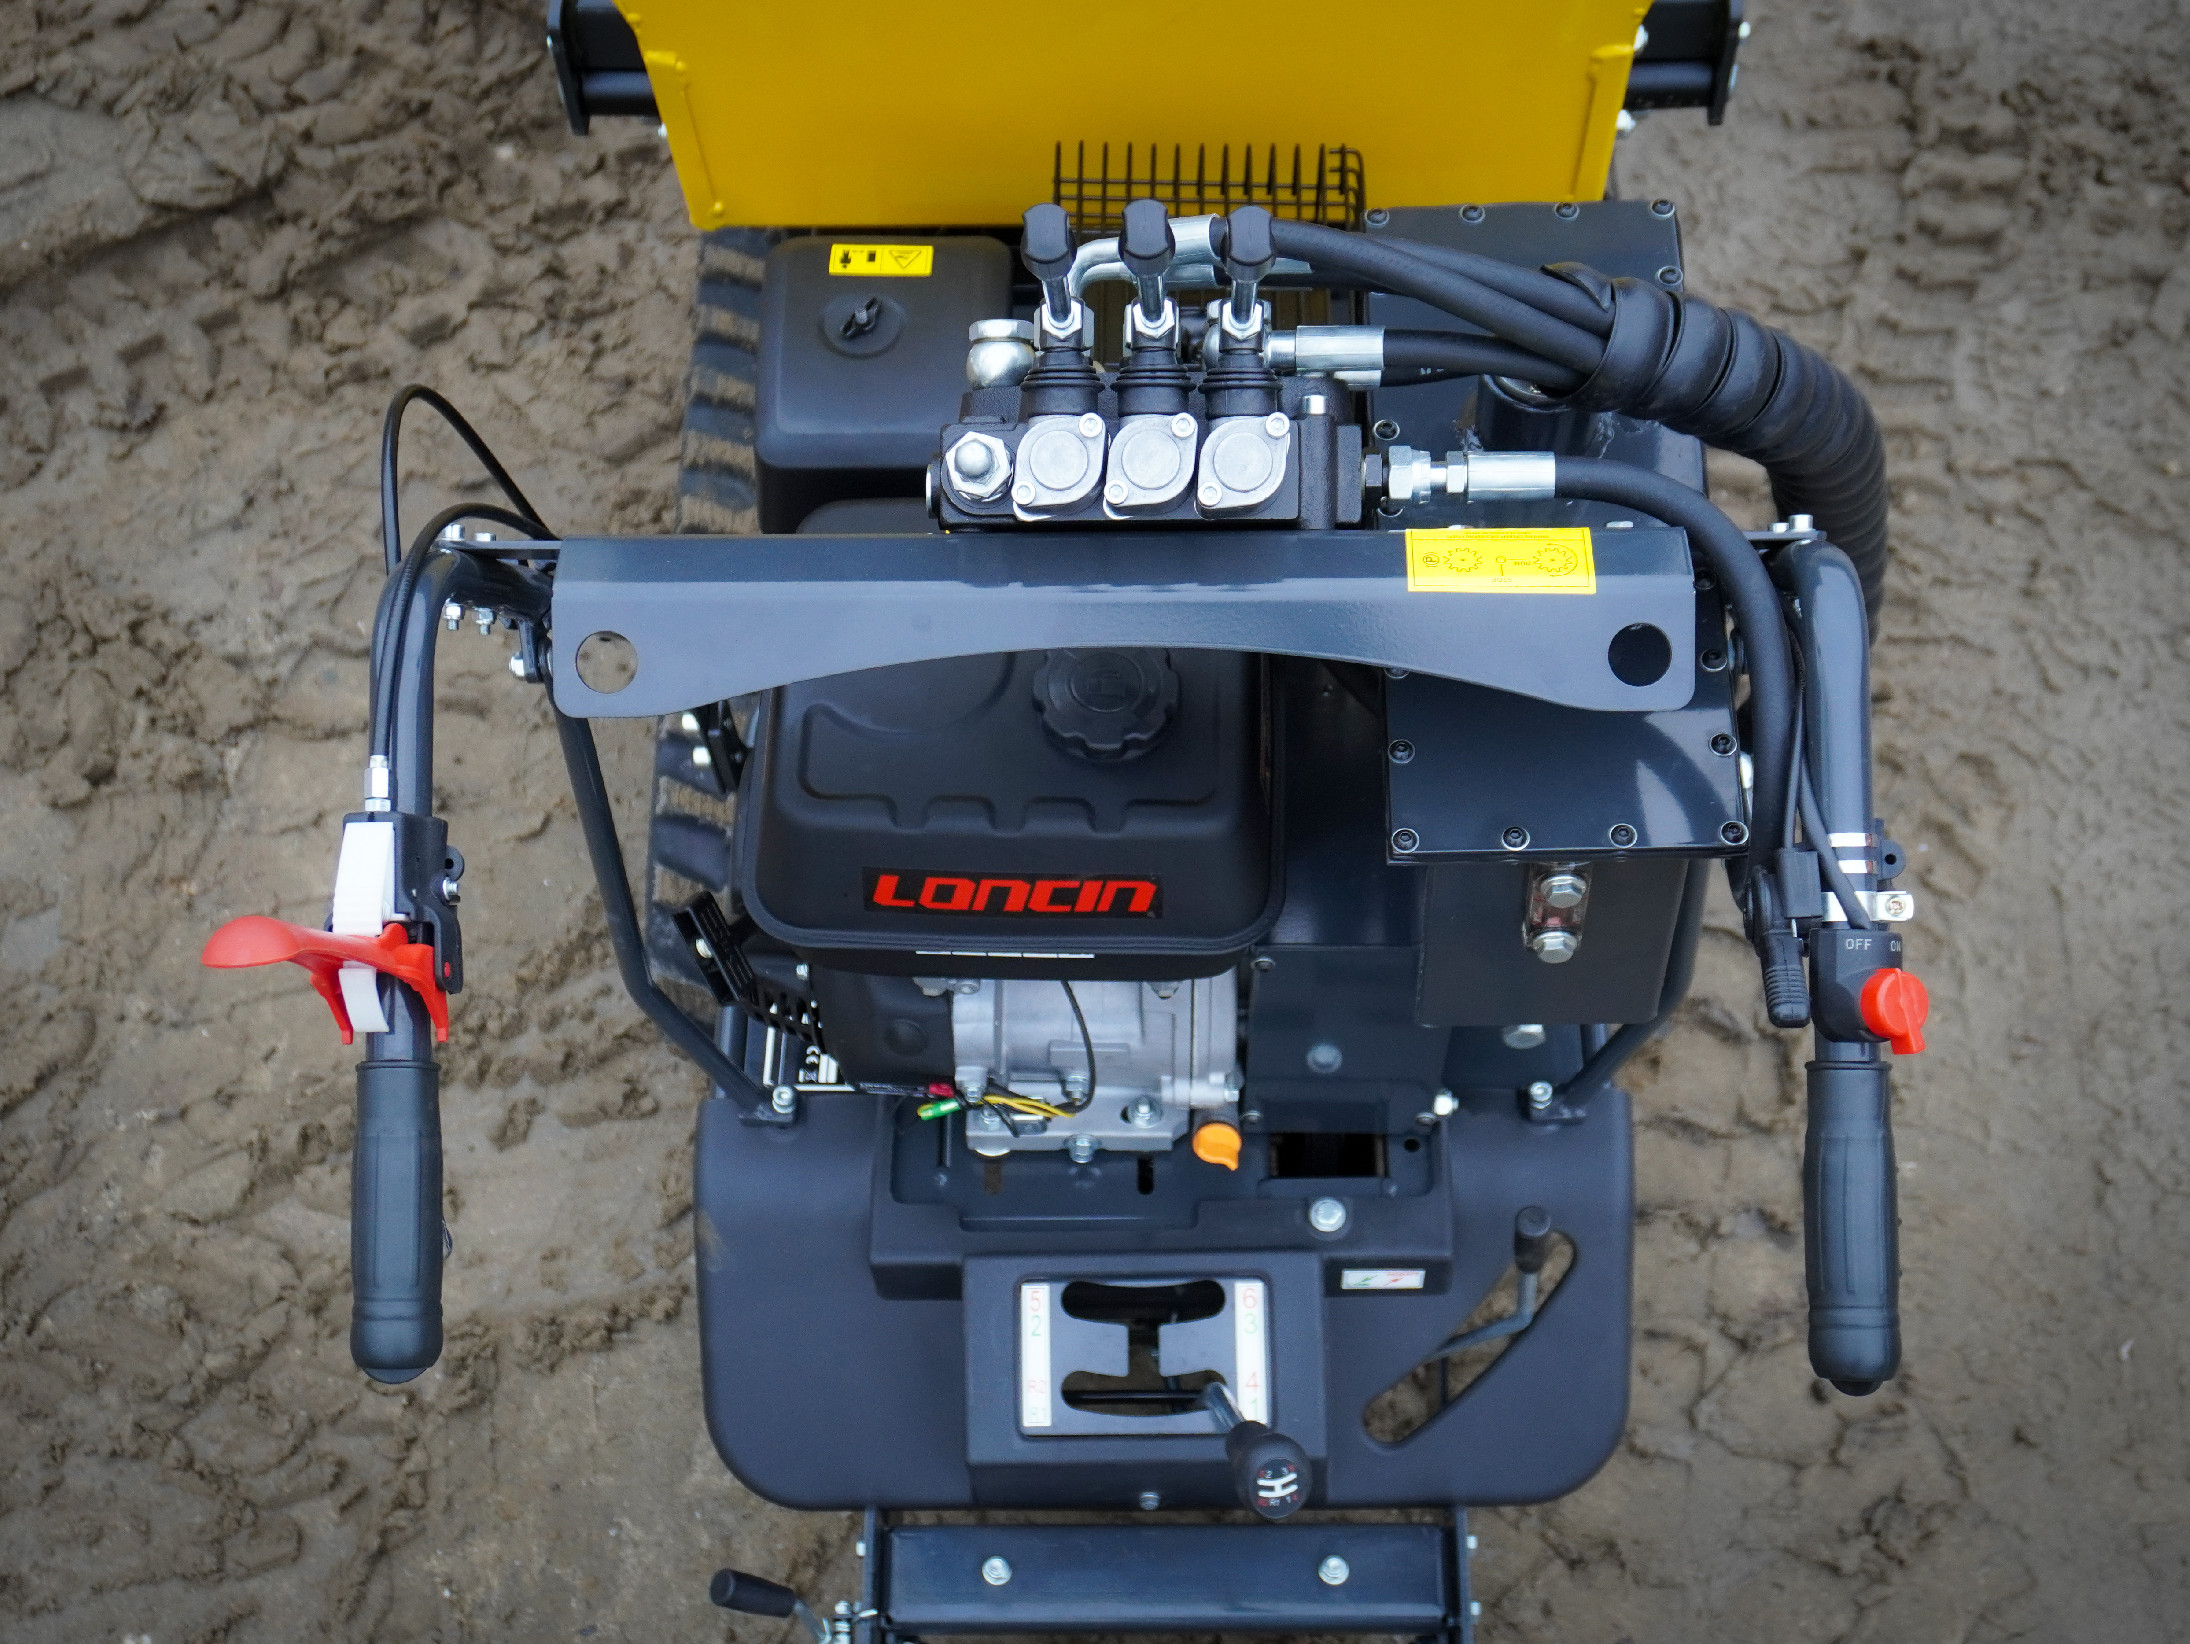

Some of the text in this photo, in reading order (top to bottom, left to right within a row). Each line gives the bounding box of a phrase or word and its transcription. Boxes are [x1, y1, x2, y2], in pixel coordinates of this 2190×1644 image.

[872, 874, 1157, 912] LONCIN
[1845, 938, 1902, 952] OFF ON
[1030, 1290, 1041, 1312] 5
[1242, 1287, 1258, 1309] 6
[1031, 1314, 1042, 1337] 2
[1243, 1312, 1258, 1335] 3
[1028, 1379, 1047, 1394] R2
[1245, 1371, 1260, 1393] 4
[1249, 1397, 1259, 1421] 1
[1265, 1470, 1272, 1478] 2
